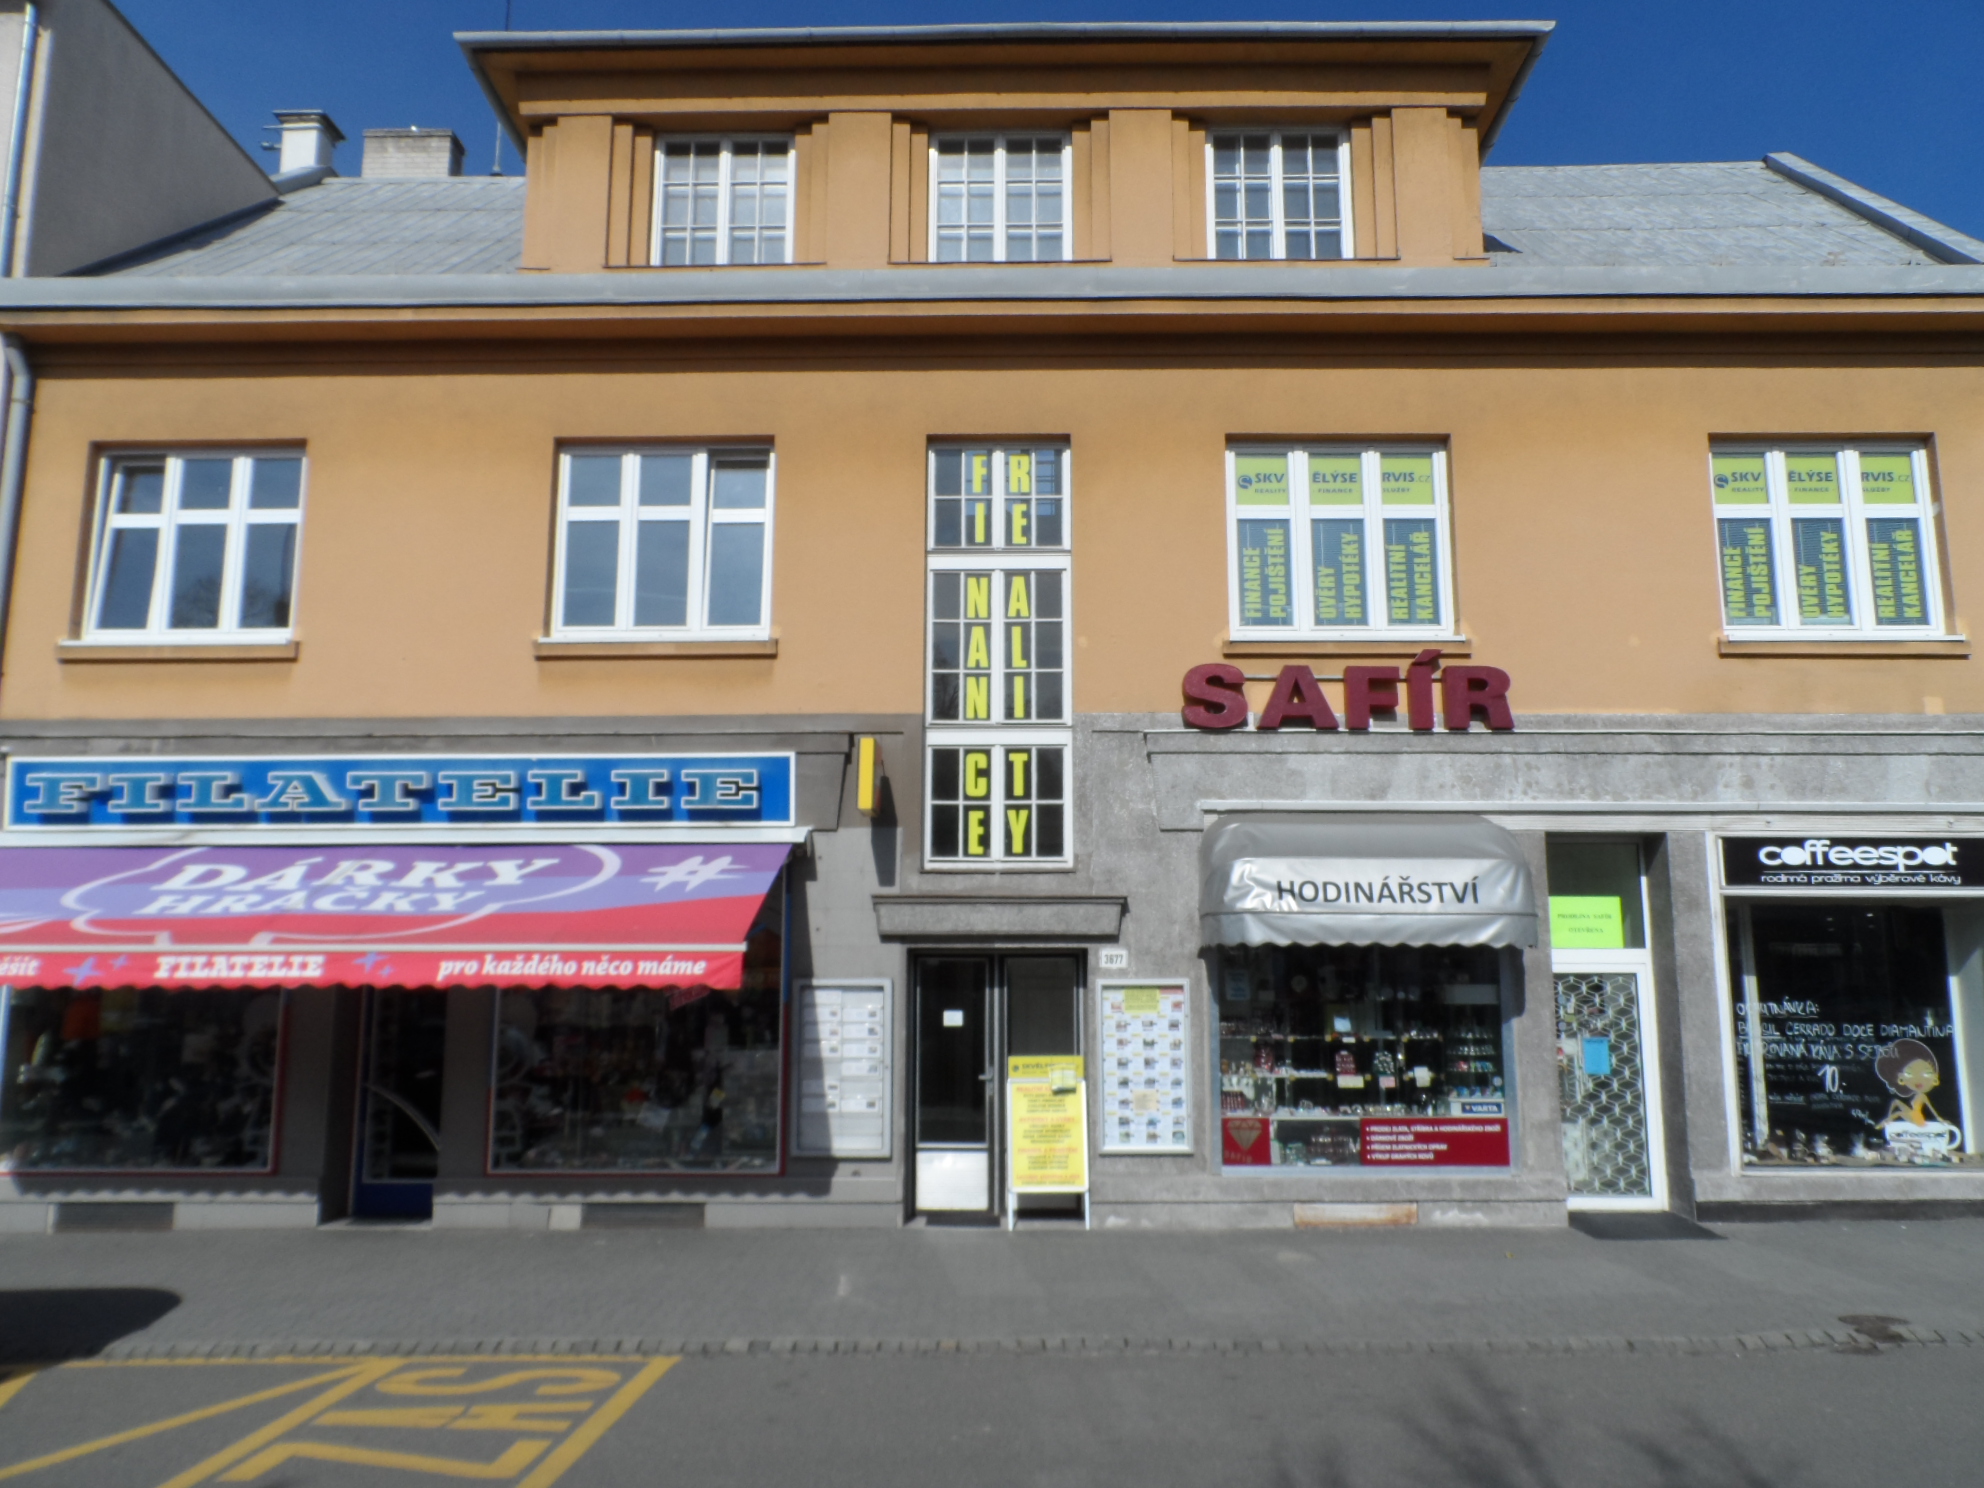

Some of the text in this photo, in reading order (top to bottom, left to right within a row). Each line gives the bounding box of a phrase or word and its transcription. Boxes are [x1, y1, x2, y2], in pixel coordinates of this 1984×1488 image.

[1243, 547, 1262, 618] FINANCE
[1264, 528, 1287, 618] POJIŠTĚNÍ
[1316, 566, 1337, 618] ÚVĚRY
[1339, 532, 1362, 618] HYPOTÉKY
[1386, 544, 1409, 619] REALITNÍ
[1410, 532, 1434, 619] KANCELÁŘ
[1723, 546, 1746, 617] FINANCE
[1181, 649, 1515, 731] SAFÍR
[24, 769, 761, 814] FILATELIE
[150, 856, 559, 892] DÁRKY
[1758, 839, 1959, 873] coffeespot
[131, 886, 485, 915] HRAČKY
[1276, 875, 1479, 904] HODINÁŘSTVÍ
[154, 955, 326, 978] FILATELIE
[437, 953, 706, 981] pro každého něco máme
